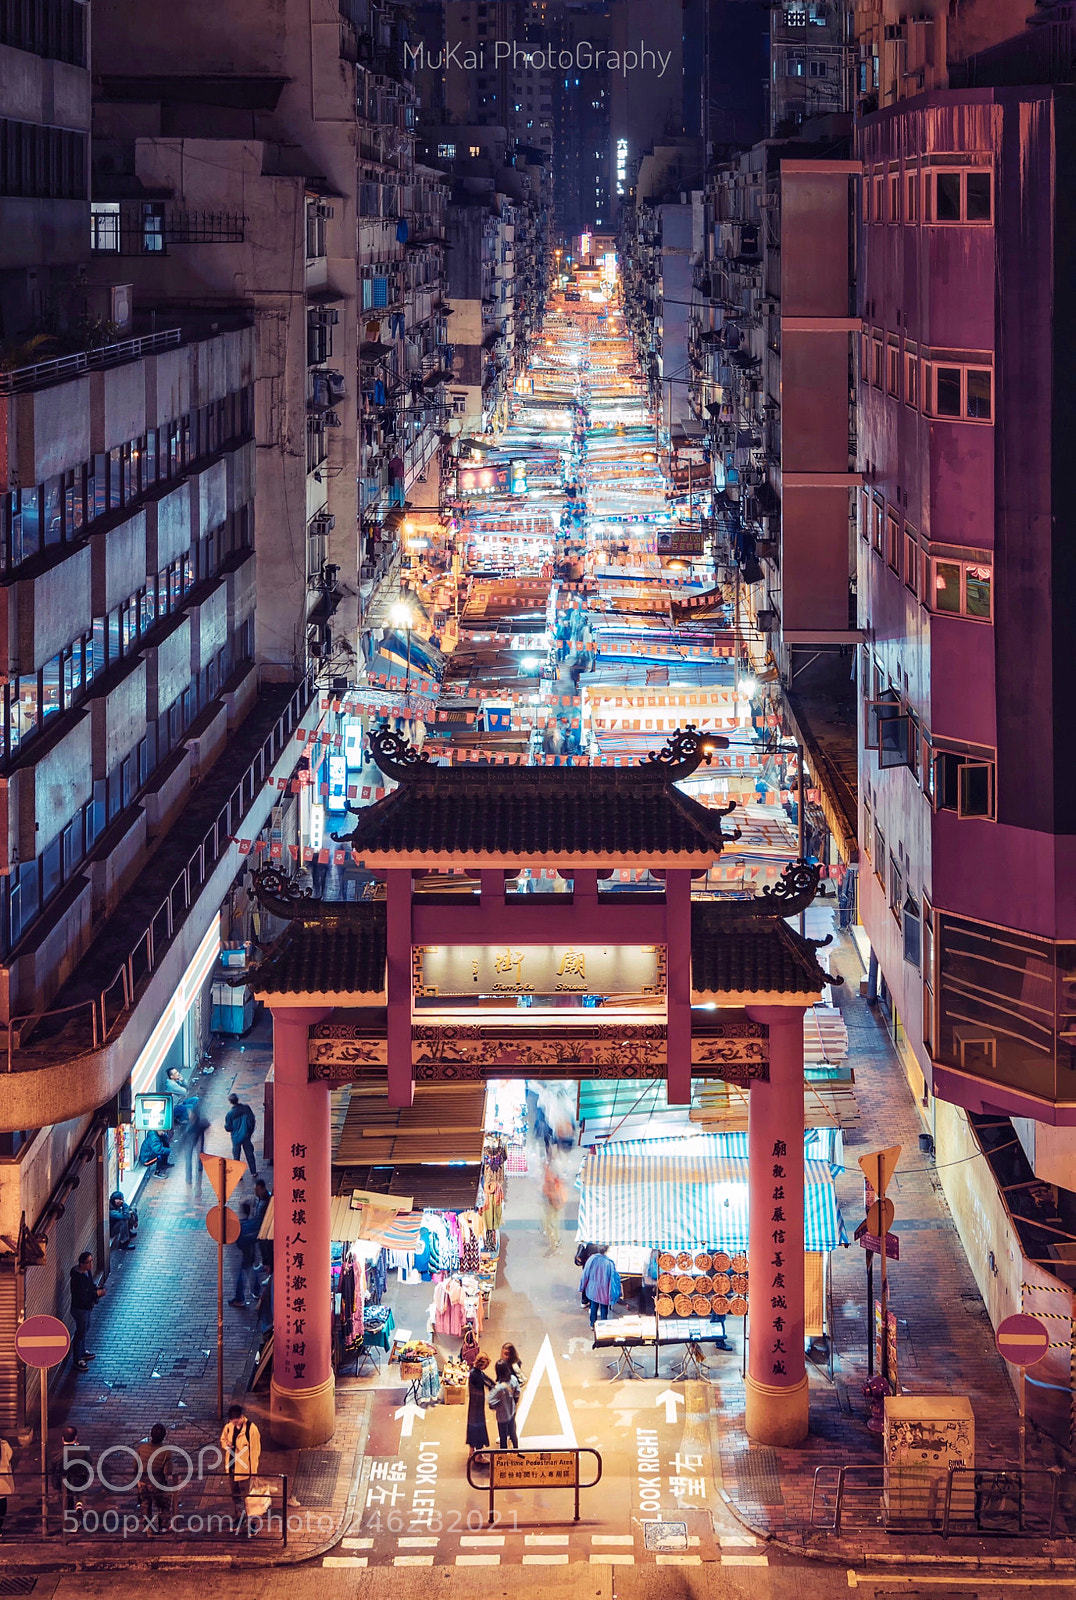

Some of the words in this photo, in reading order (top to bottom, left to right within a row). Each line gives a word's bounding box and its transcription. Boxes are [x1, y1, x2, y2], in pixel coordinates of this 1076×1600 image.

[492, 982, 536, 993] Temple
[555, 982, 589, 993] Street
[415, 1441, 441, 1485] LOOK
[526, 1459, 557, 1467] Pedestrian
[636, 1427, 660, 1472] RIGHT
[409, 1489, 436, 1526] LEFT
[637, 1476, 663, 1523] LOOK
